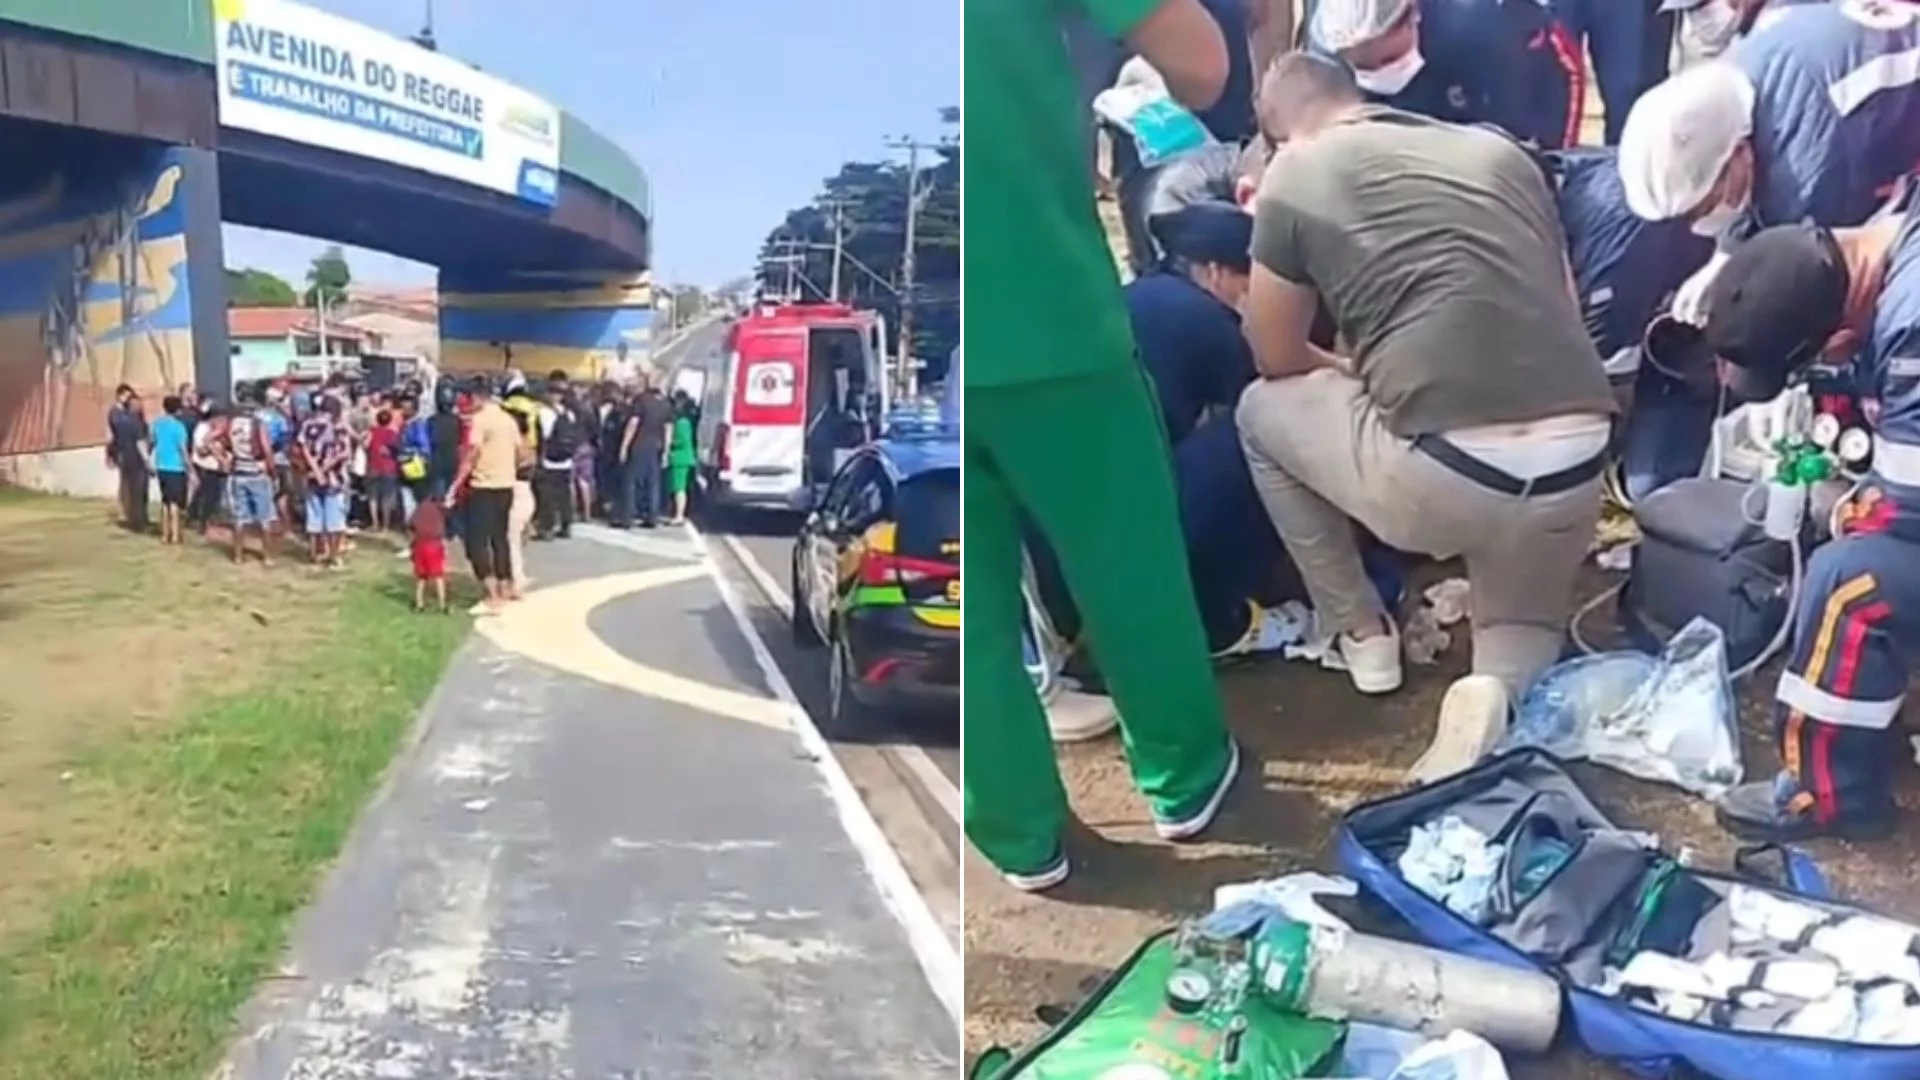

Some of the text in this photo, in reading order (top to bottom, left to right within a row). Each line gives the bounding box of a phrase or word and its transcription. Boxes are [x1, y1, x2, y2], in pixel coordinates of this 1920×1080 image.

[227, 20, 483, 122] AVENIDA DO REGGAE
[247, 71, 351, 116] TRABALHO
[353, 97, 377, 121] DA
[381, 104, 465, 148] PREFEITURA
